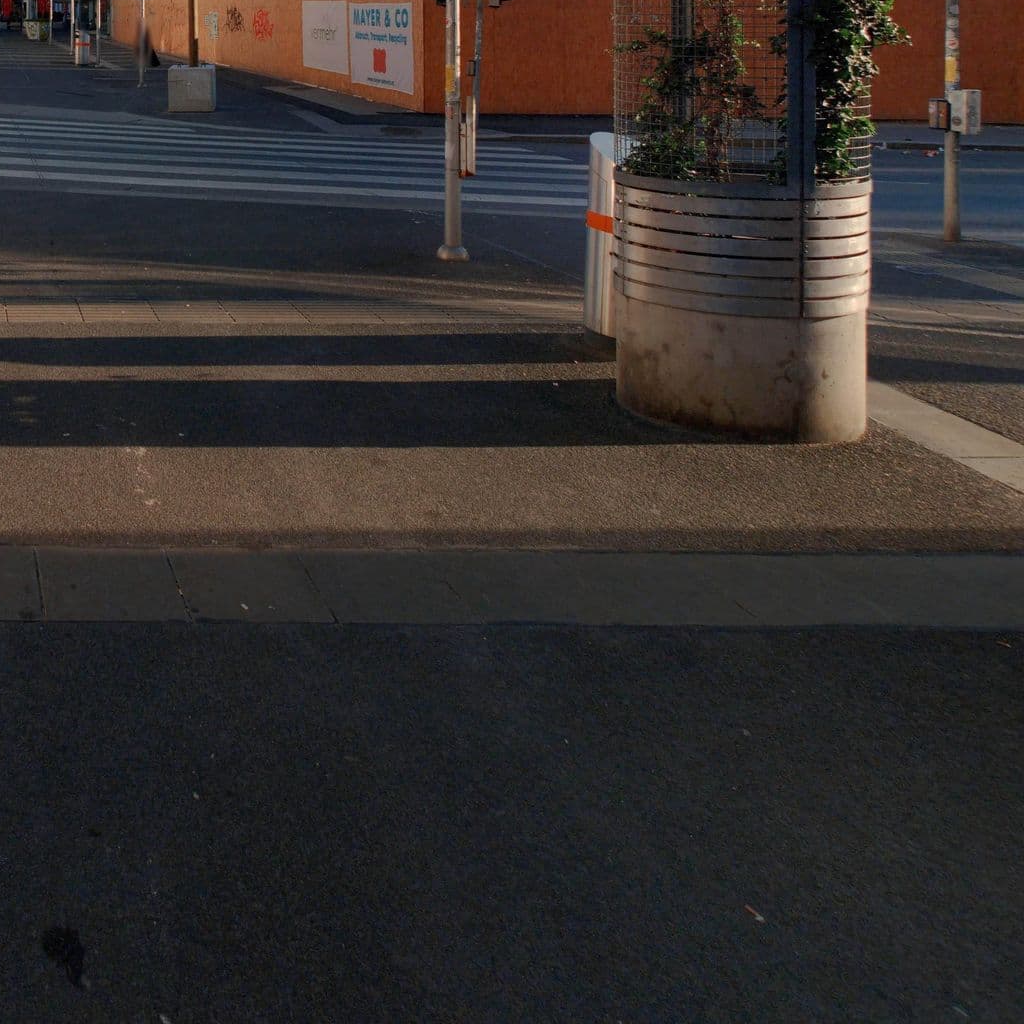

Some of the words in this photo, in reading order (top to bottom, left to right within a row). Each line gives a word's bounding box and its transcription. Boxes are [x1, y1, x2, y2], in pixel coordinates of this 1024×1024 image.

[353, 8, 381, 27] MAYER
[384, 9, 391, 28] &
[395, 8, 409, 28] CO
